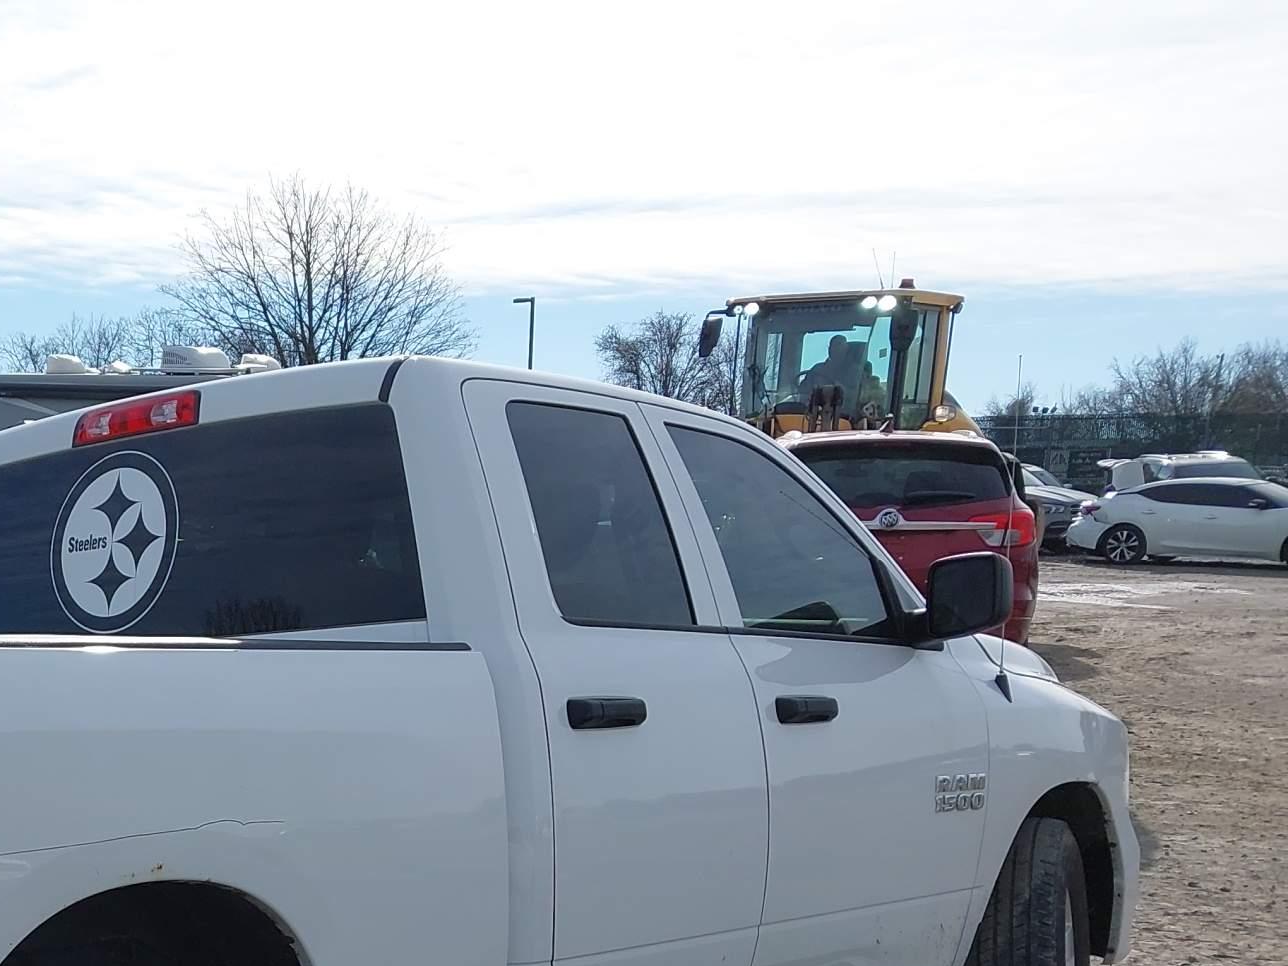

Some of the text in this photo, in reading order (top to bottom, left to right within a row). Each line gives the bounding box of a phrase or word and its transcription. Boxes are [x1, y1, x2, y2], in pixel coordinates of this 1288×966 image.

[68, 534, 107, 553] Steelers
[935, 774, 985, 792] RAM
[935, 792, 985, 812] 1500
